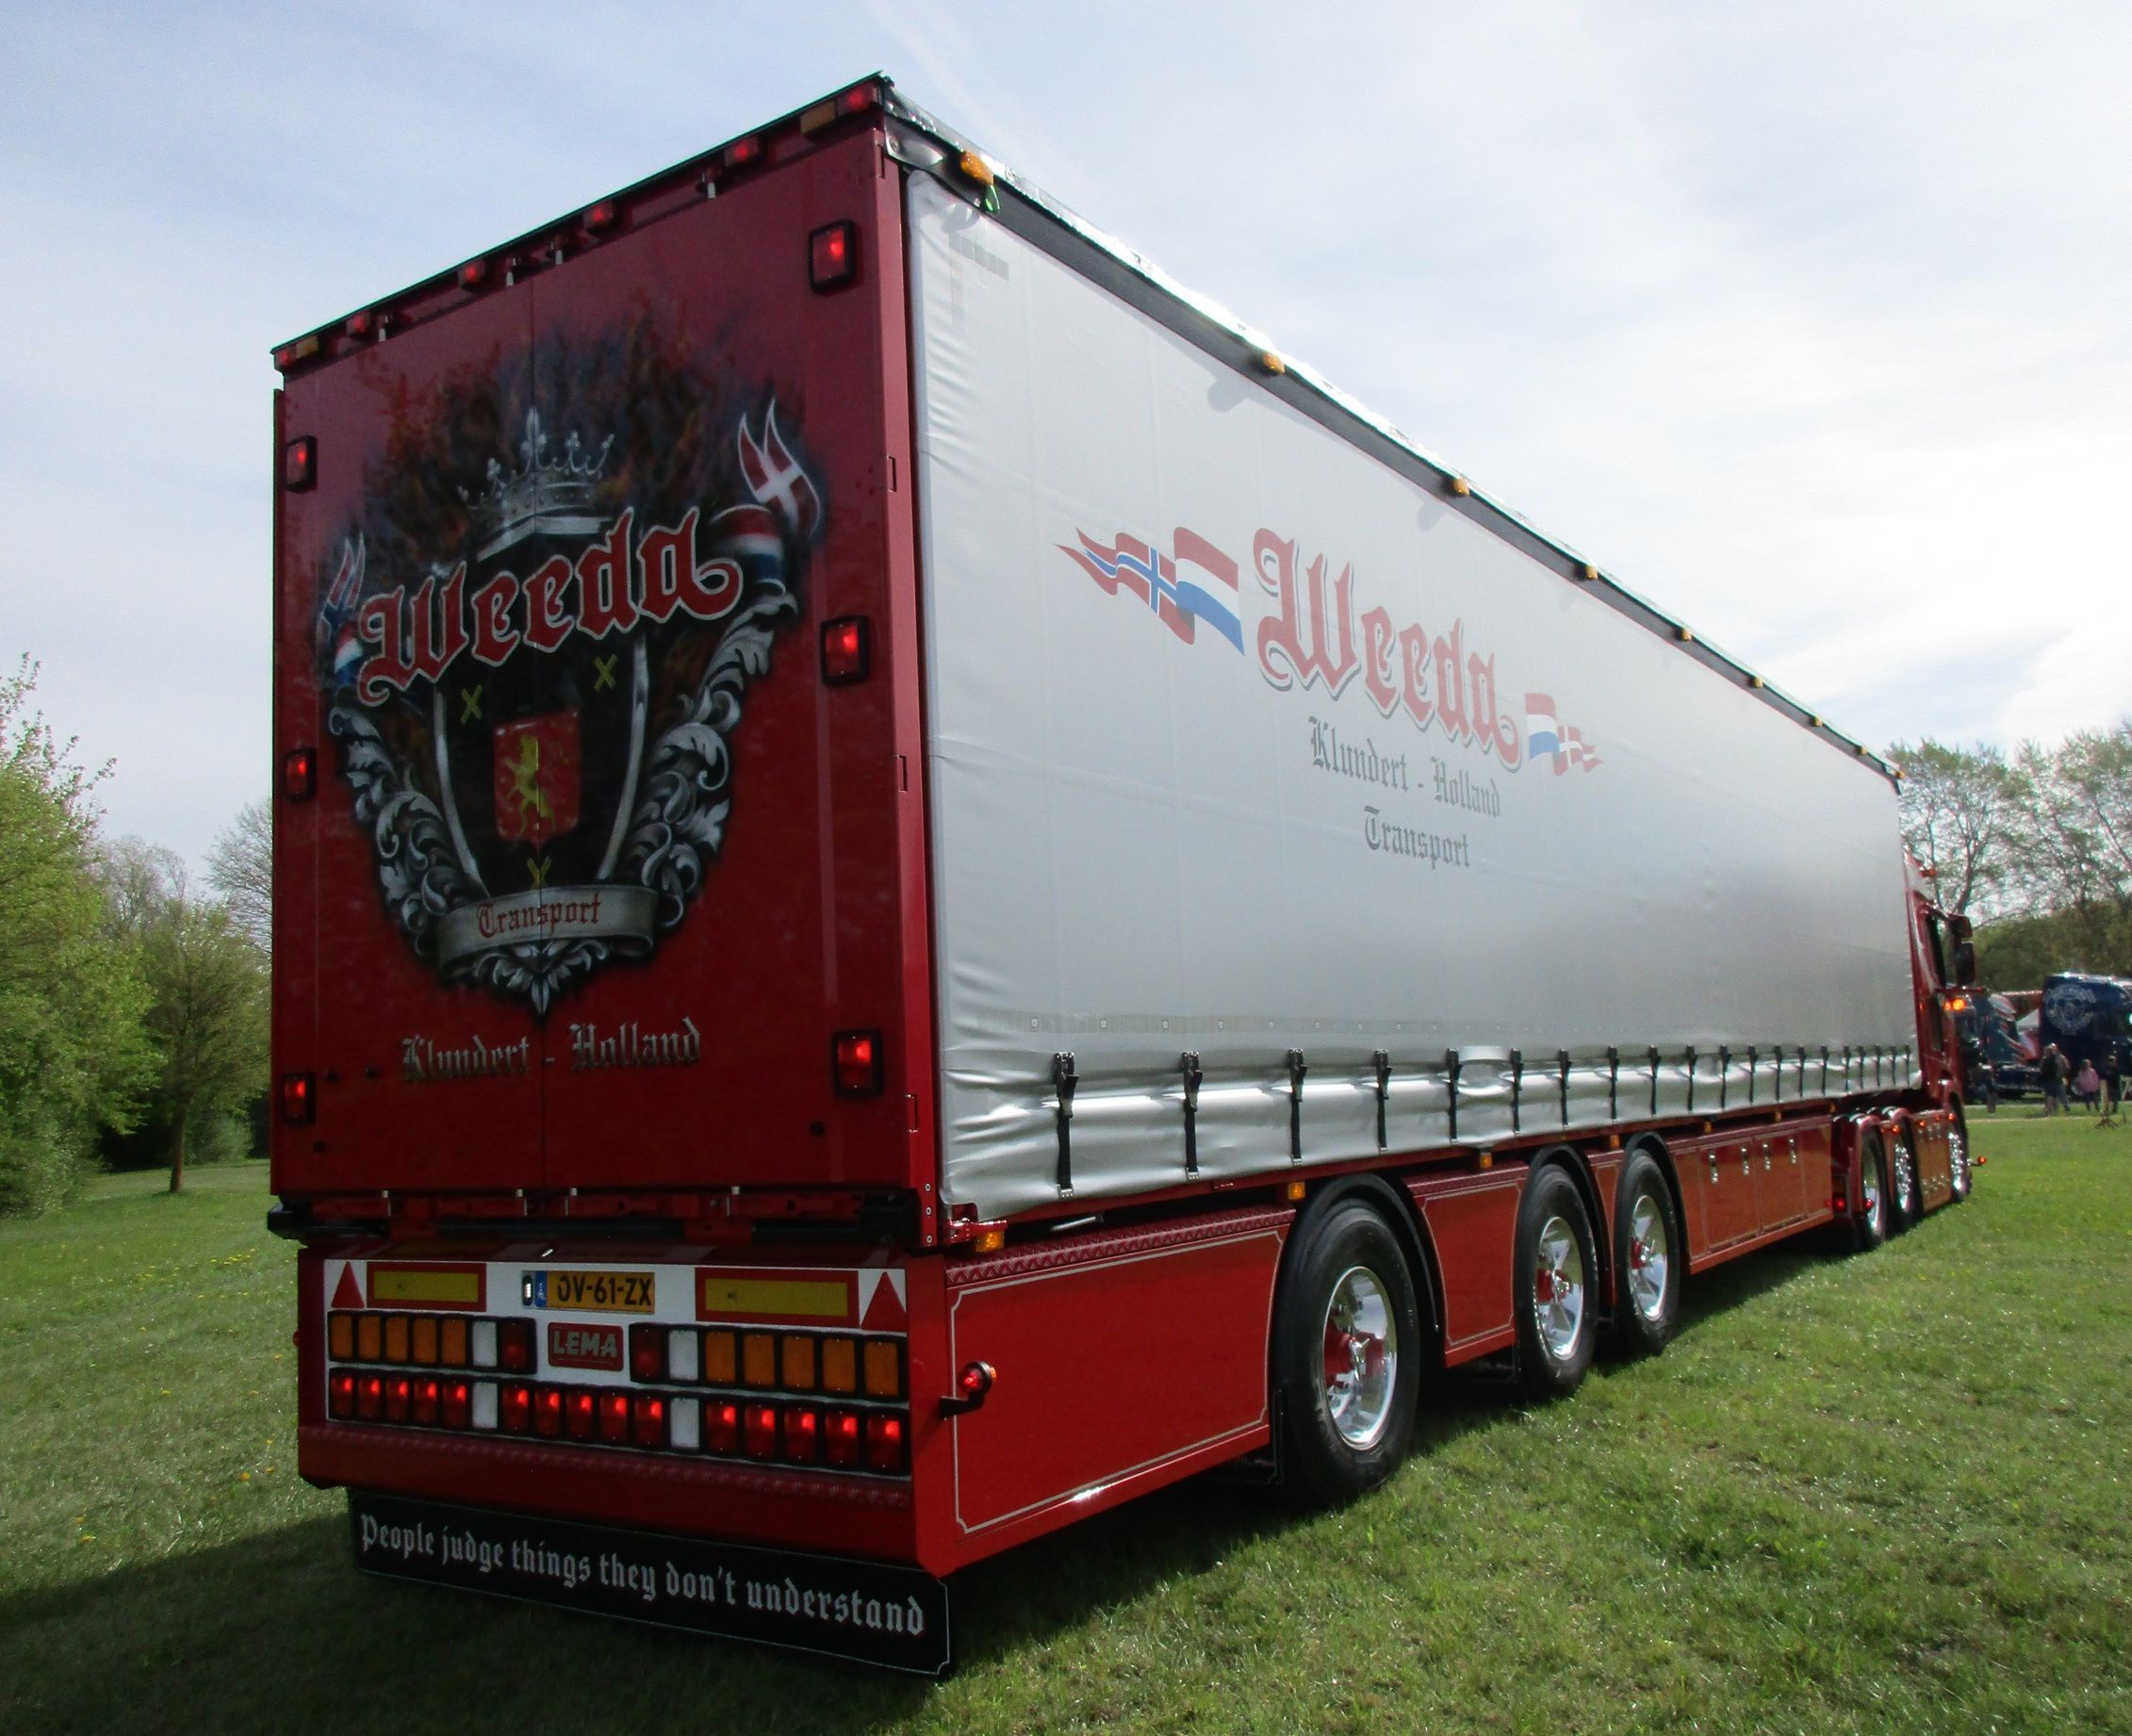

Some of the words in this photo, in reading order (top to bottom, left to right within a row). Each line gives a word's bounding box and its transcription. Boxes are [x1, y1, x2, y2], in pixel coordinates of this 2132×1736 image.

[356, 506, 743, 707] Weeda
[1253, 527, 1523, 774] Weeda
[1308, 716, 1409, 793] Klundert
[1431, 756, 1501, 818] Holland
[1364, 805, 1470, 870] Transport
[476, 892, 602, 939] Transport
[401, 1034, 531, 1083] Klundert
[568, 1016, 702, 1072] Holland
[557, 1275, 652, 1306] OV-61-ZX
[552, 1330, 618, 1358] LEMA
[360, 1514, 435, 1560] People
[442, 1527, 504, 1572] judge
[511, 1539, 591, 1588] things
[599, 1552, 657, 1601] they
[665, 1562, 737, 1606] don't
[746, 1577, 926, 1637] understand
